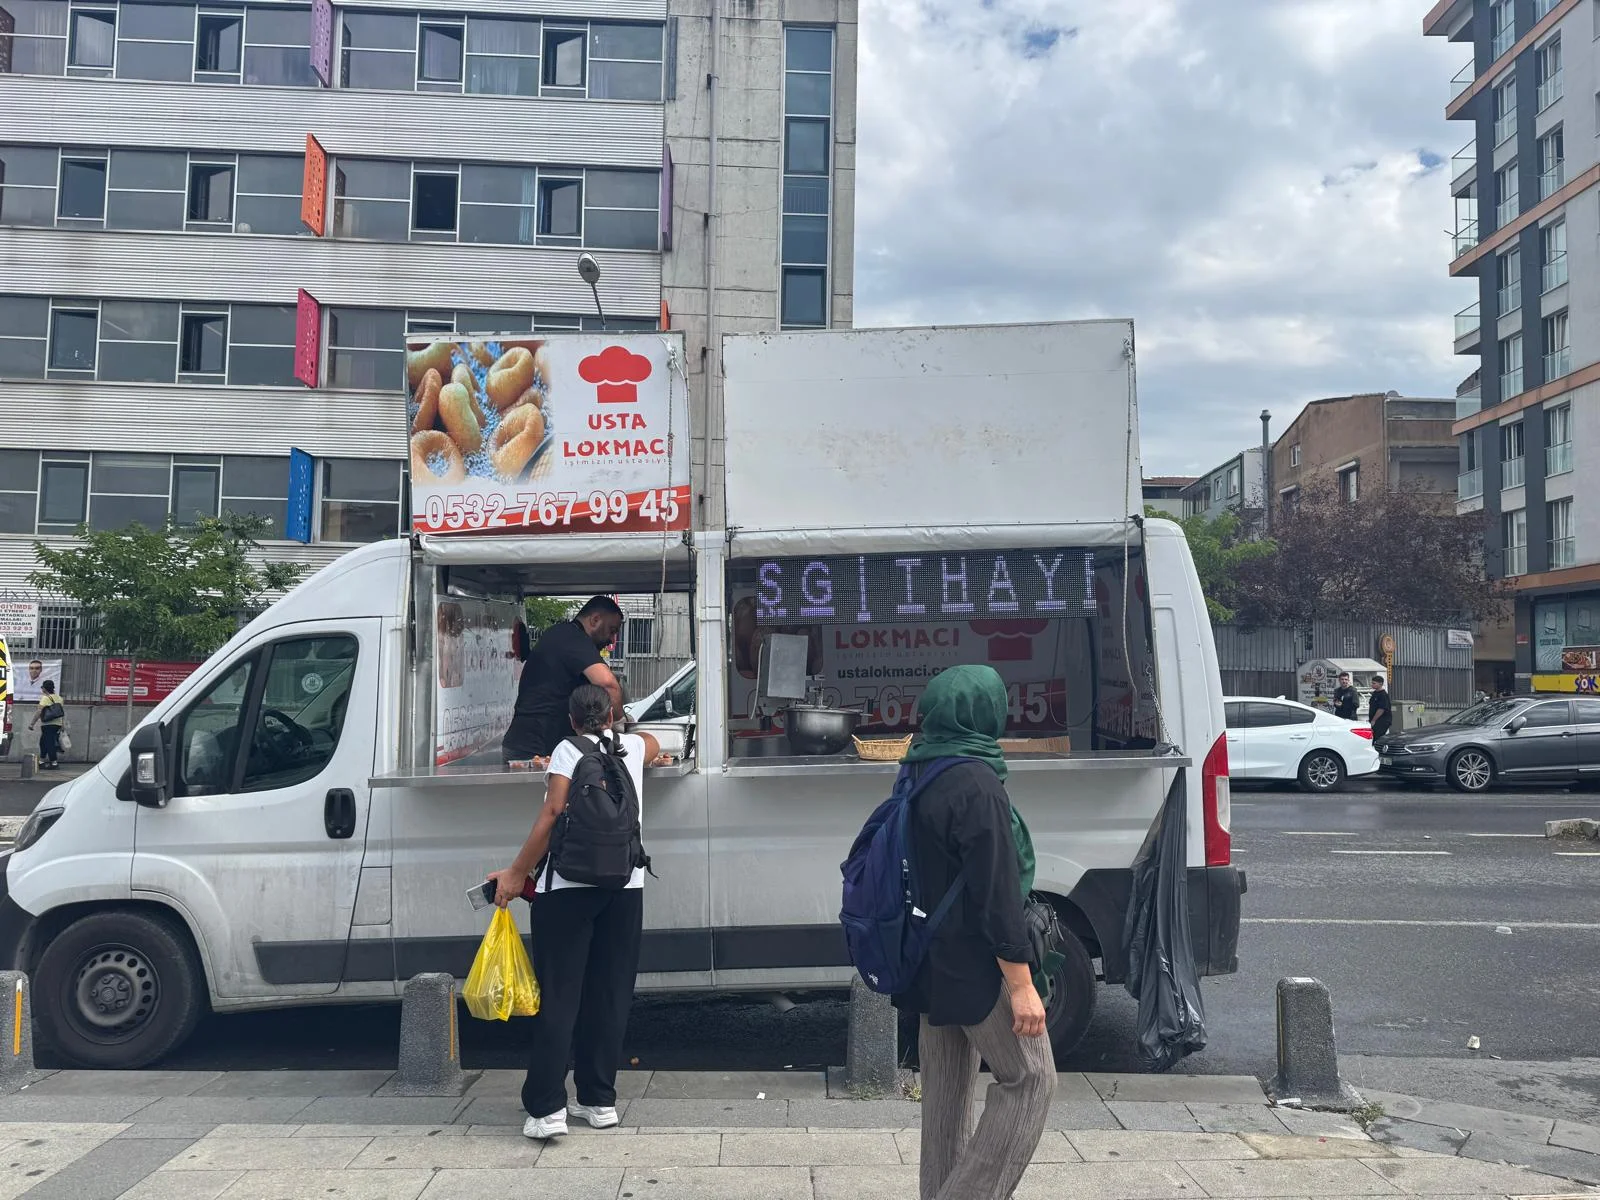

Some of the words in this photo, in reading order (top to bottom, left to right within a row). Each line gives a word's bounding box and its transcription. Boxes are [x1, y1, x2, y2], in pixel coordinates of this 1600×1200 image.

[588, 412, 646, 430] USTA
[425, 495, 506, 529] 0532
[516, 490, 578, 527] 767
[588, 490, 628, 525] 99
[639, 489, 679, 523] 45
[835, 627, 960, 649] LOKMACI
[837, 664, 948, 679] ustalokmaci.co
